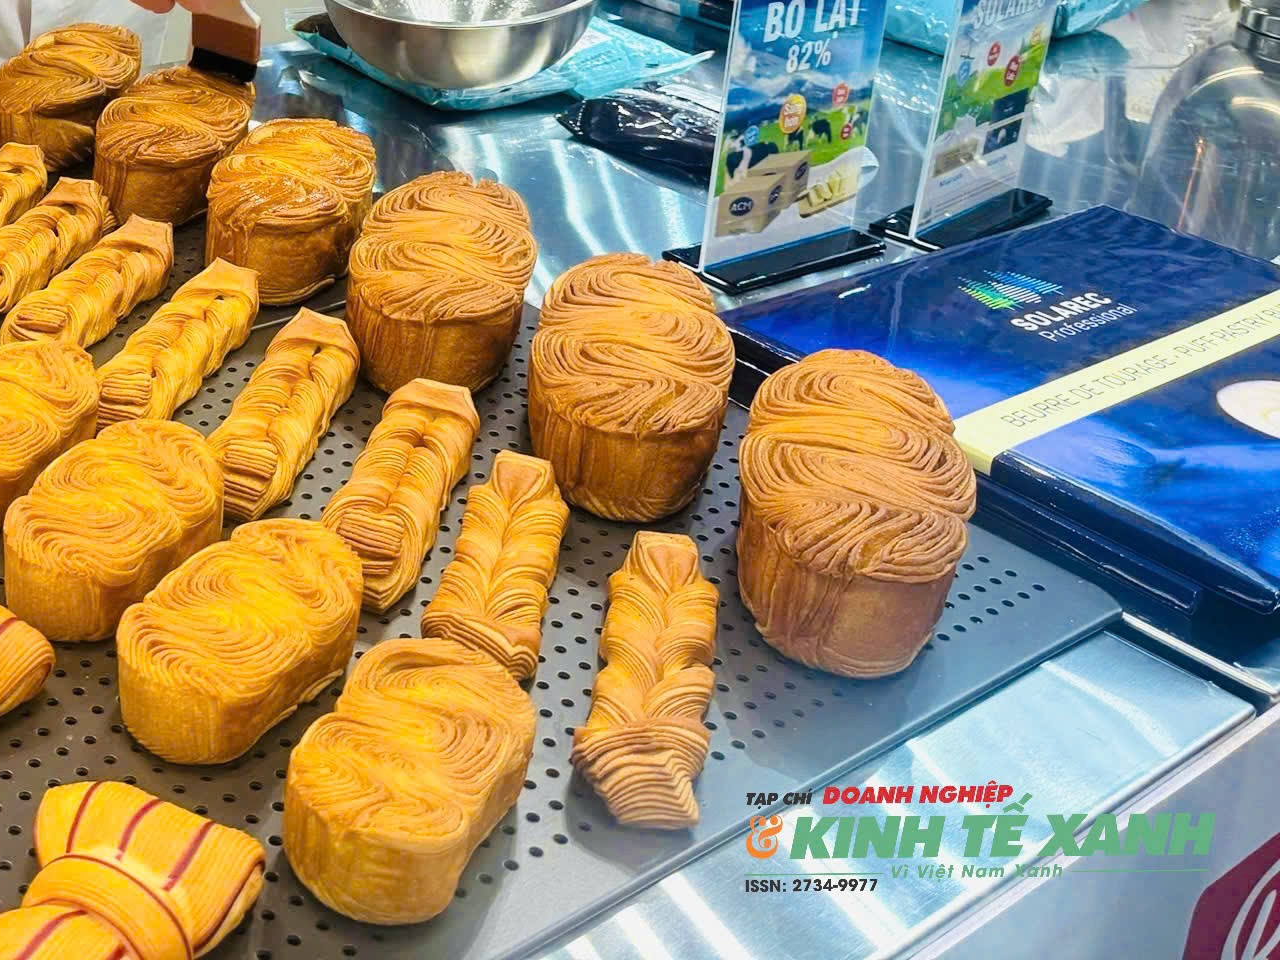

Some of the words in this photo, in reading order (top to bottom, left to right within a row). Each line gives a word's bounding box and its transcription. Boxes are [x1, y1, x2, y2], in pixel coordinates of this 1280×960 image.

[785, 38, 832, 74] 82%
[1010, 292, 1112, 332] SOLAREC
[1038, 302, 1138, 343] Professional
[1001, 394, 1080, 429] BEURRE
[1070, 381, 1103, 402] DE
[1094, 353, 1177, 394] TOURAGE
[1177, 333, 1219, 359] PUFF
